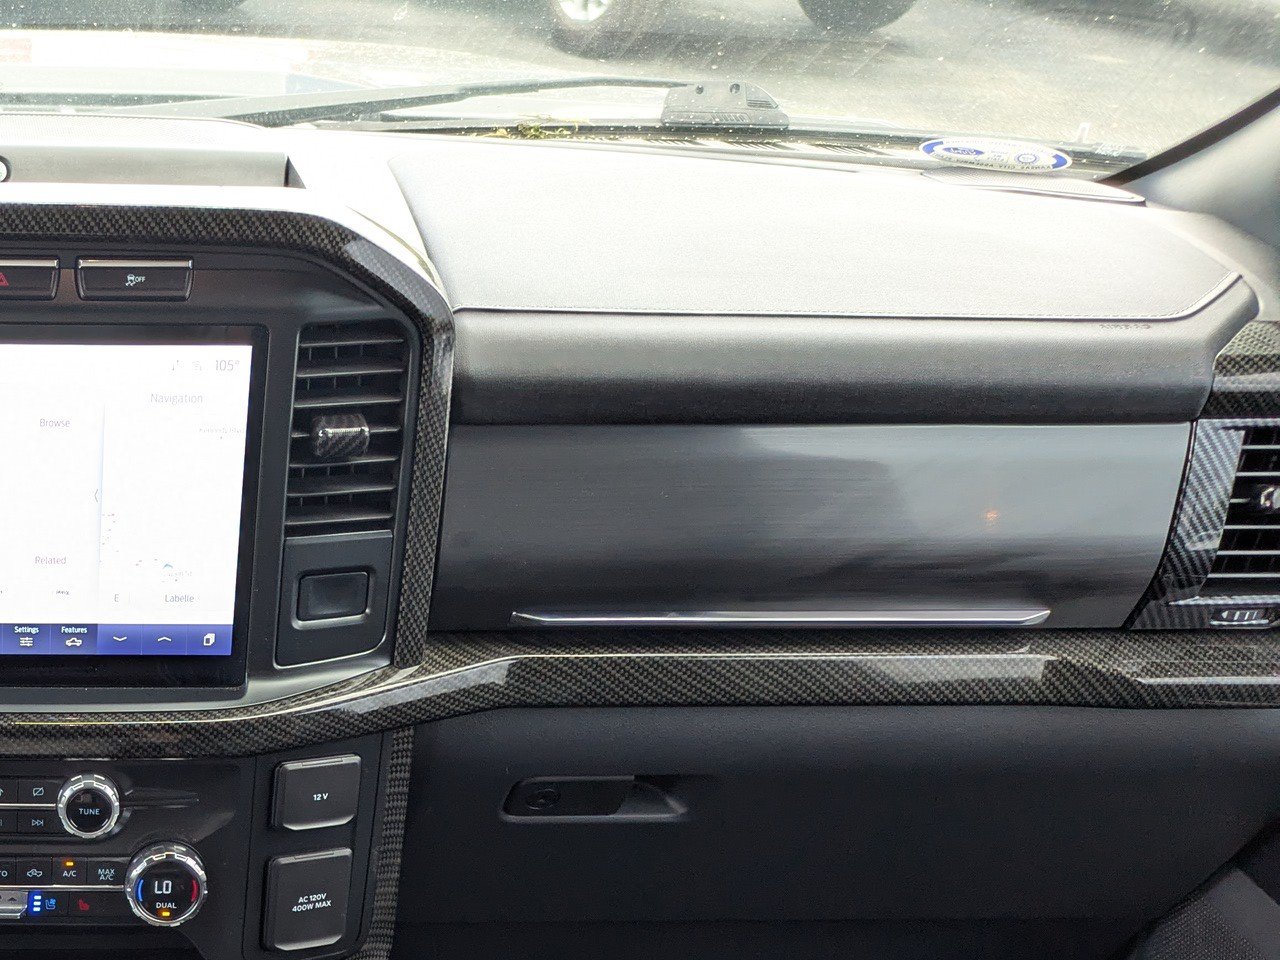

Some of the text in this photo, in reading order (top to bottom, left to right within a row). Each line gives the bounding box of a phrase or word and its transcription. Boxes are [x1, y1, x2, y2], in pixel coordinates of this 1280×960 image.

[134, 275, 146, 283] OFF
[150, 393, 203, 406] Navigation
[39, 418, 70, 428] Browse
[34, 555, 67, 565] Related
[14, 626, 39, 635] Settings
[61, 626, 88, 634] Features
[322, 792, 329, 801] V
[78, 807, 101, 816] TUNE
[62, 869, 77, 878] A/C
[98, 868, 115, 876] MAX
[154, 880, 172, 895] LO
[298, 892, 327, 904] AC 120V
[155, 901, 177, 910] DUAL
[292, 900, 332, 913] 400W MAX
